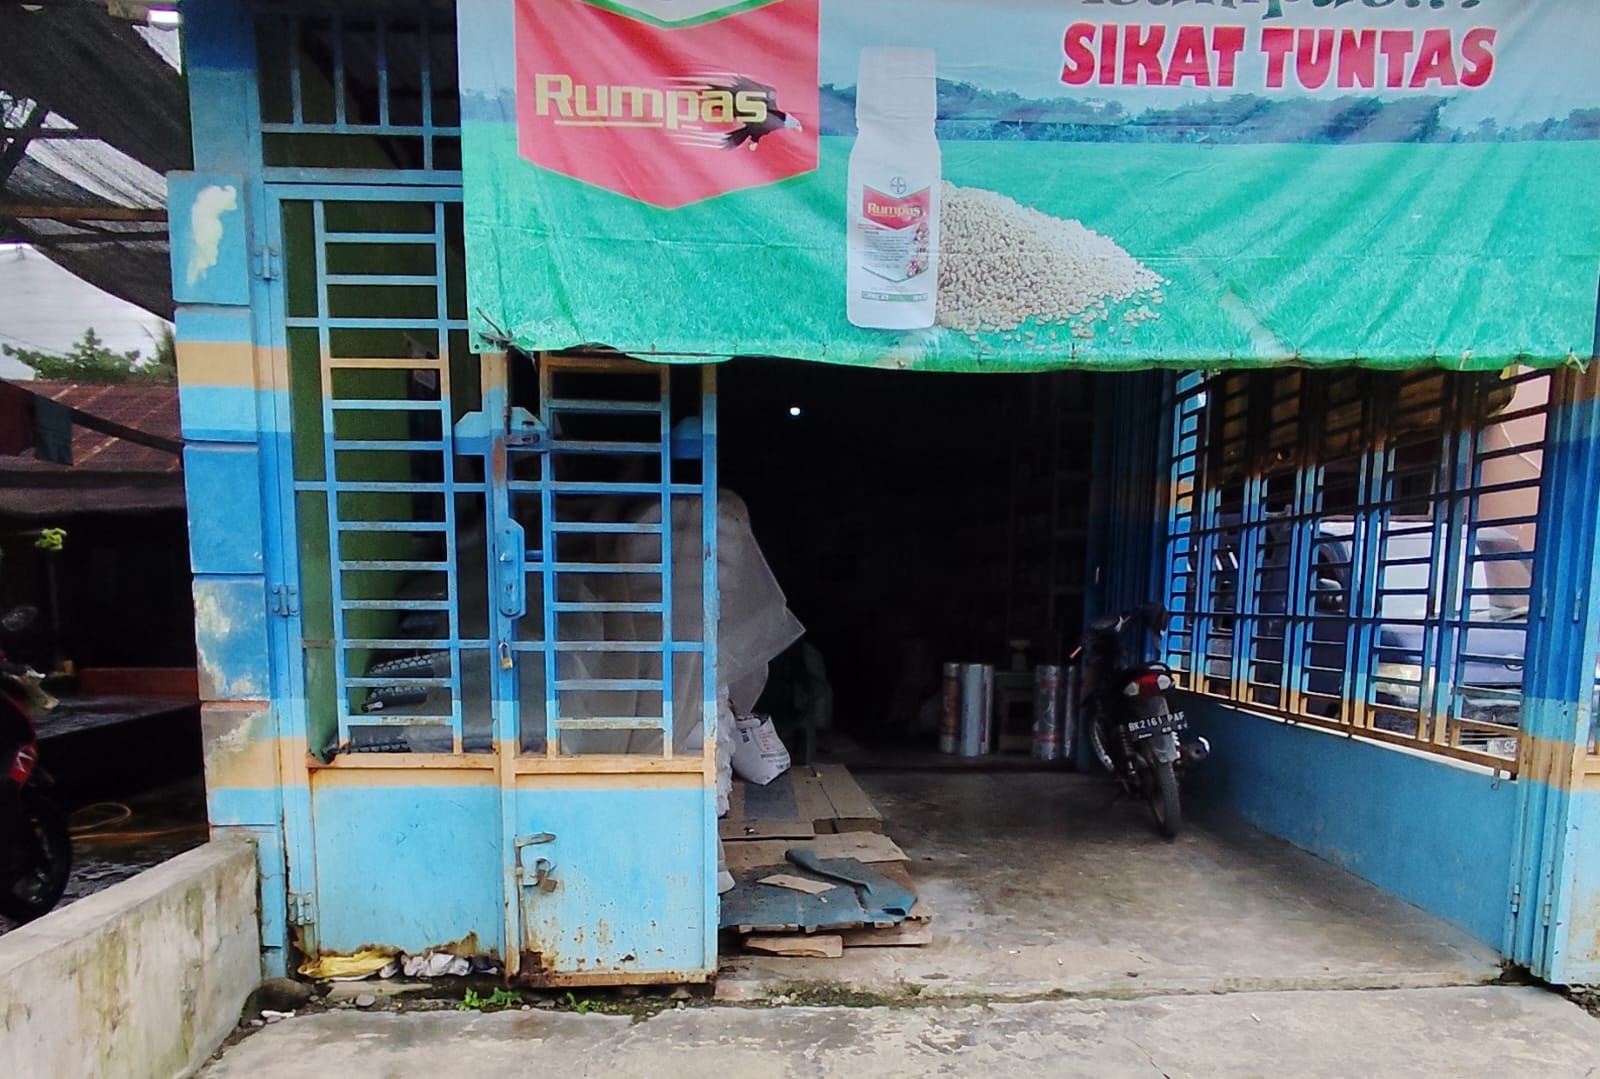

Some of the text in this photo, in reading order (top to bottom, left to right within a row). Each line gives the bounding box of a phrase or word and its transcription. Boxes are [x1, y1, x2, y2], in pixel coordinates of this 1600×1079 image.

[1060, 22, 1497, 90] SIKAT TUNTAS
[535, 73, 768, 130] Rumpas
[867, 202, 921, 217] Rumpas
